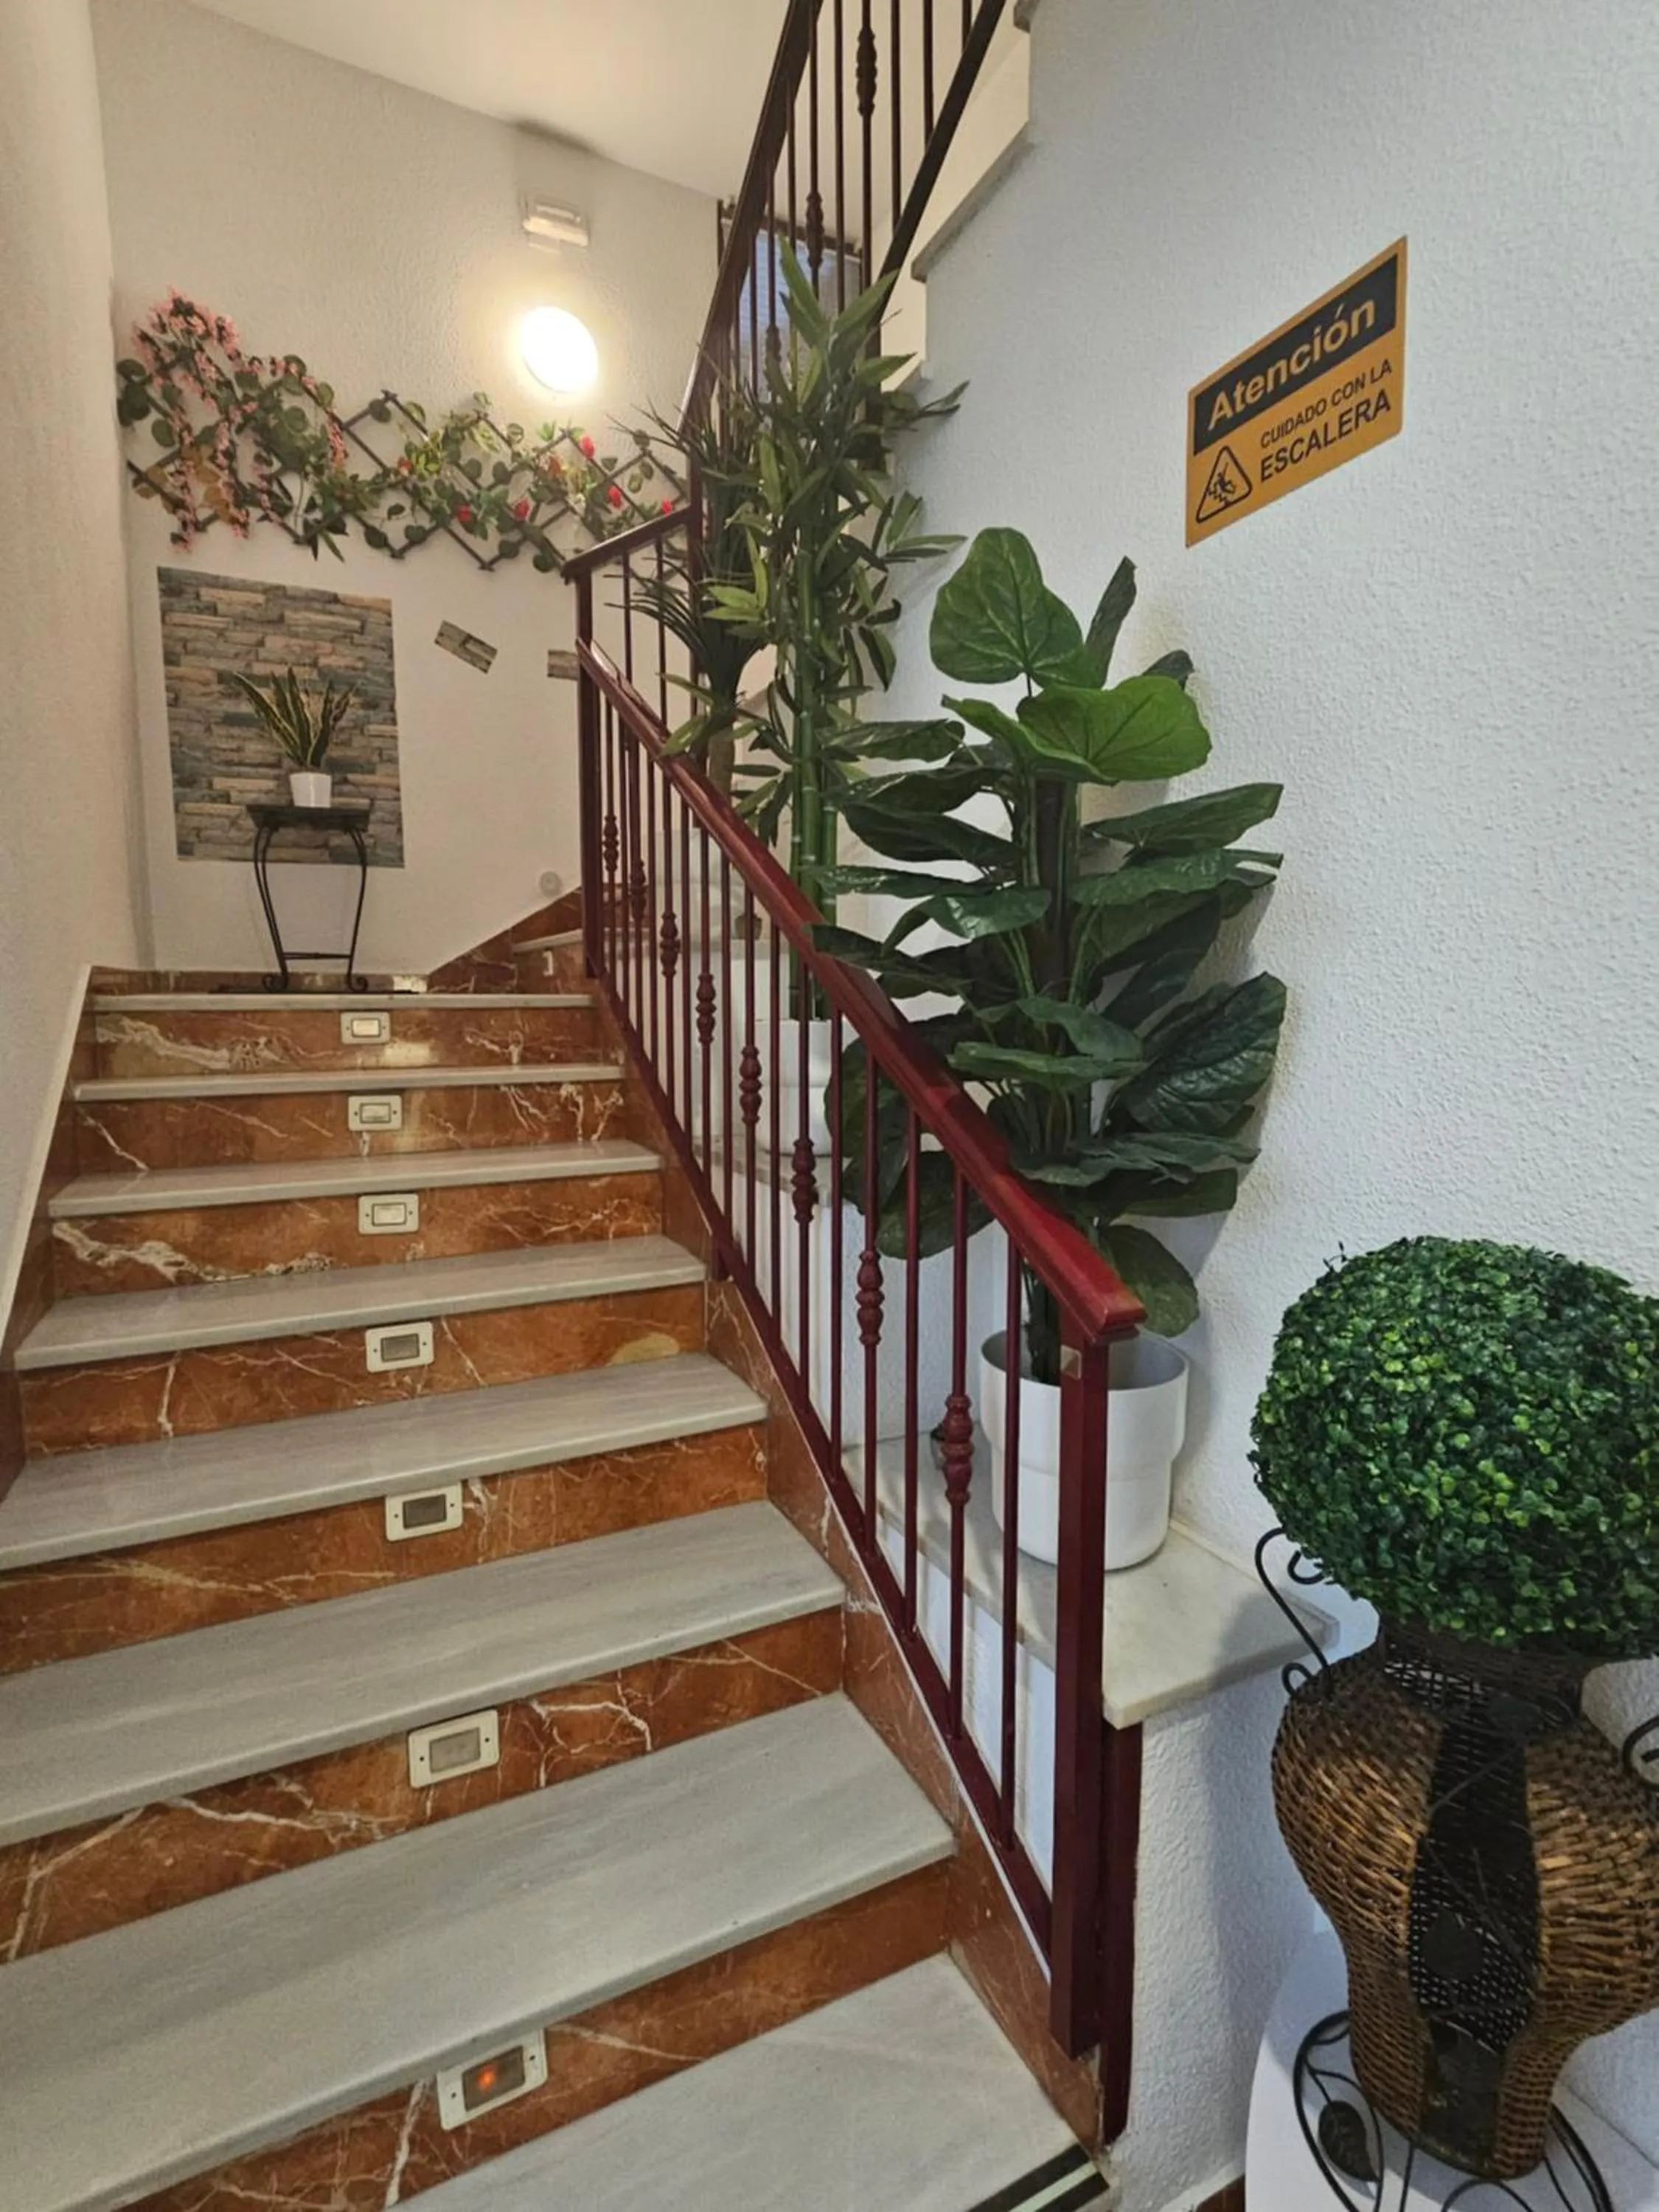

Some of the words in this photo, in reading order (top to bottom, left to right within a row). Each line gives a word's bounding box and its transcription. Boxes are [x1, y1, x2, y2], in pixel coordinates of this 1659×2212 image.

[1208, 298, 1375, 431] Atención
[1261, 398, 1326, 449] CUIDADO
[1331, 372, 1366, 407] CON
[1370, 358, 1392, 383] LA
[1261, 389, 1391, 483] ESCALERA
